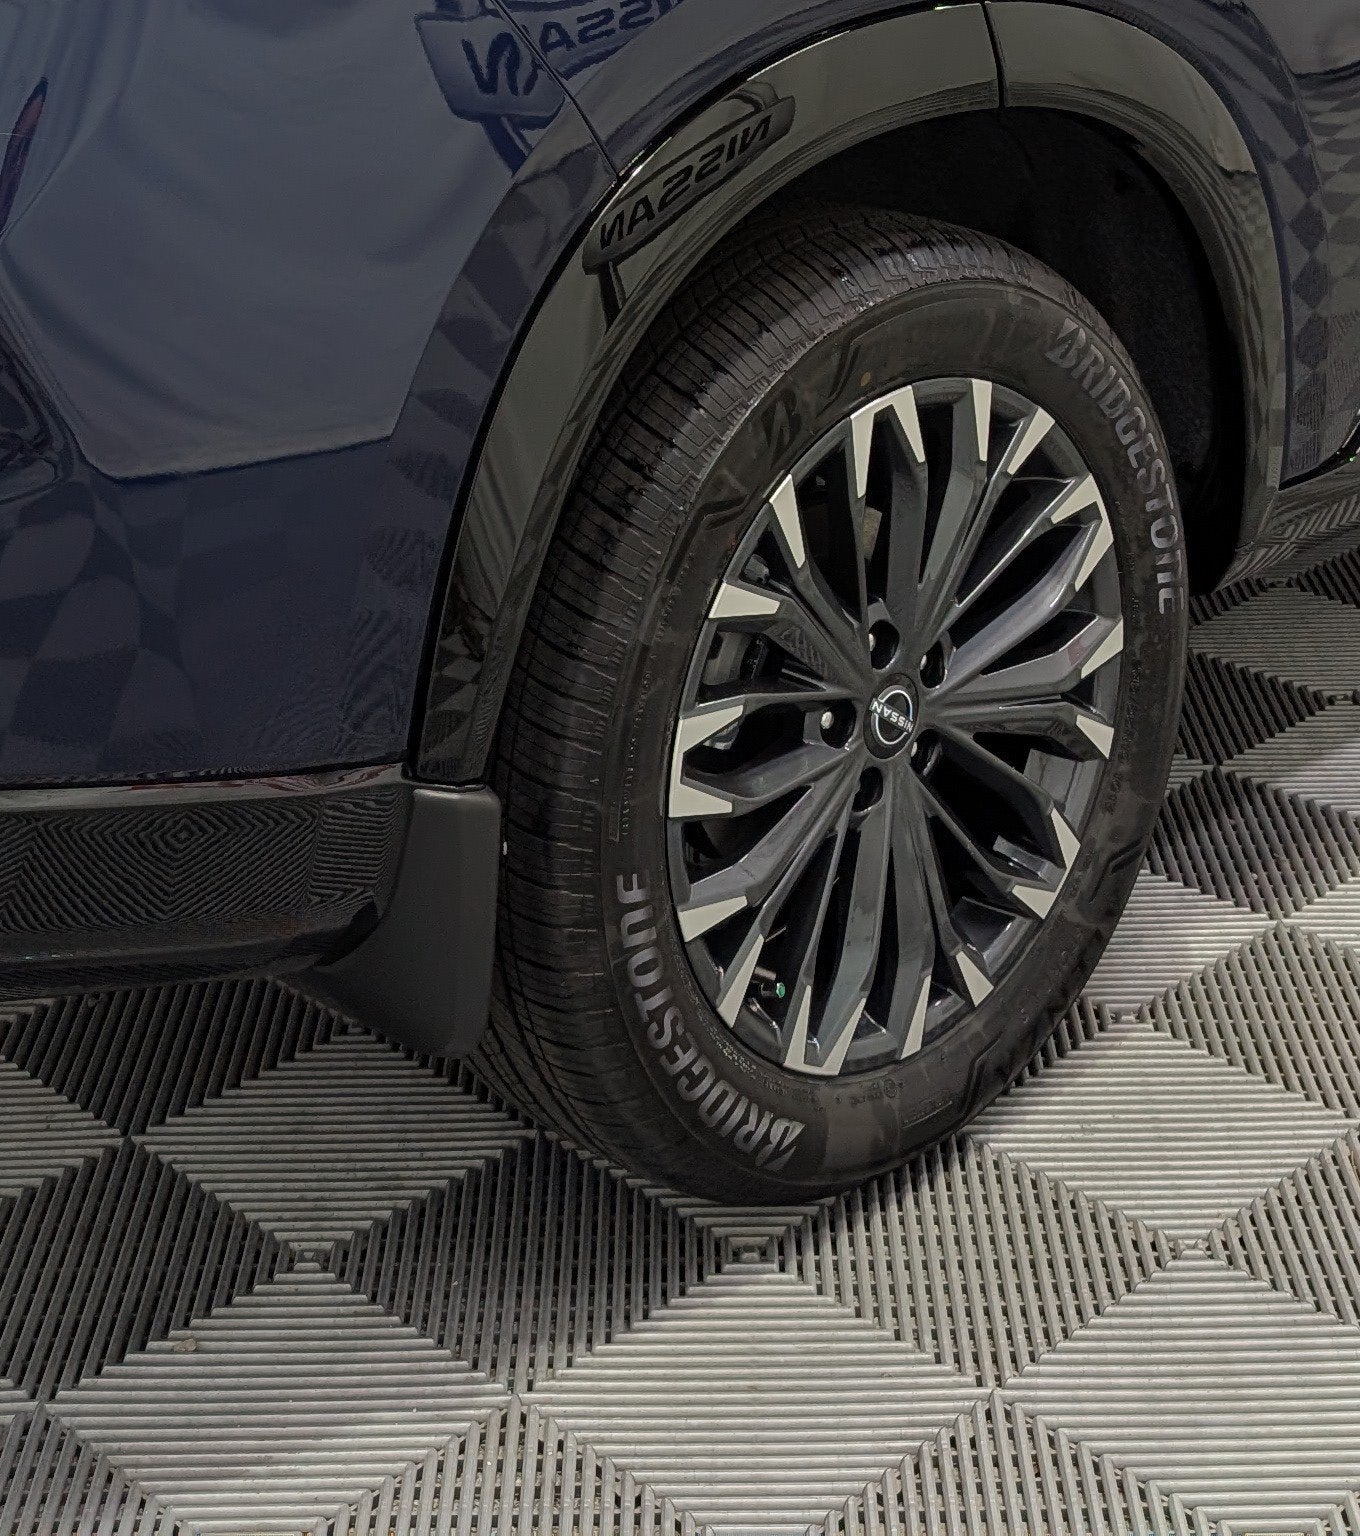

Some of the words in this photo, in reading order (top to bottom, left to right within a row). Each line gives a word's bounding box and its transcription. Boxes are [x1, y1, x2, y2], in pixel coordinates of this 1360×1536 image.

[1044, 317, 1186, 615] BRIDGESTONE
[871, 701, 914, 733] NISSAN
[615, 872, 807, 1172] BRIDGESTONE
